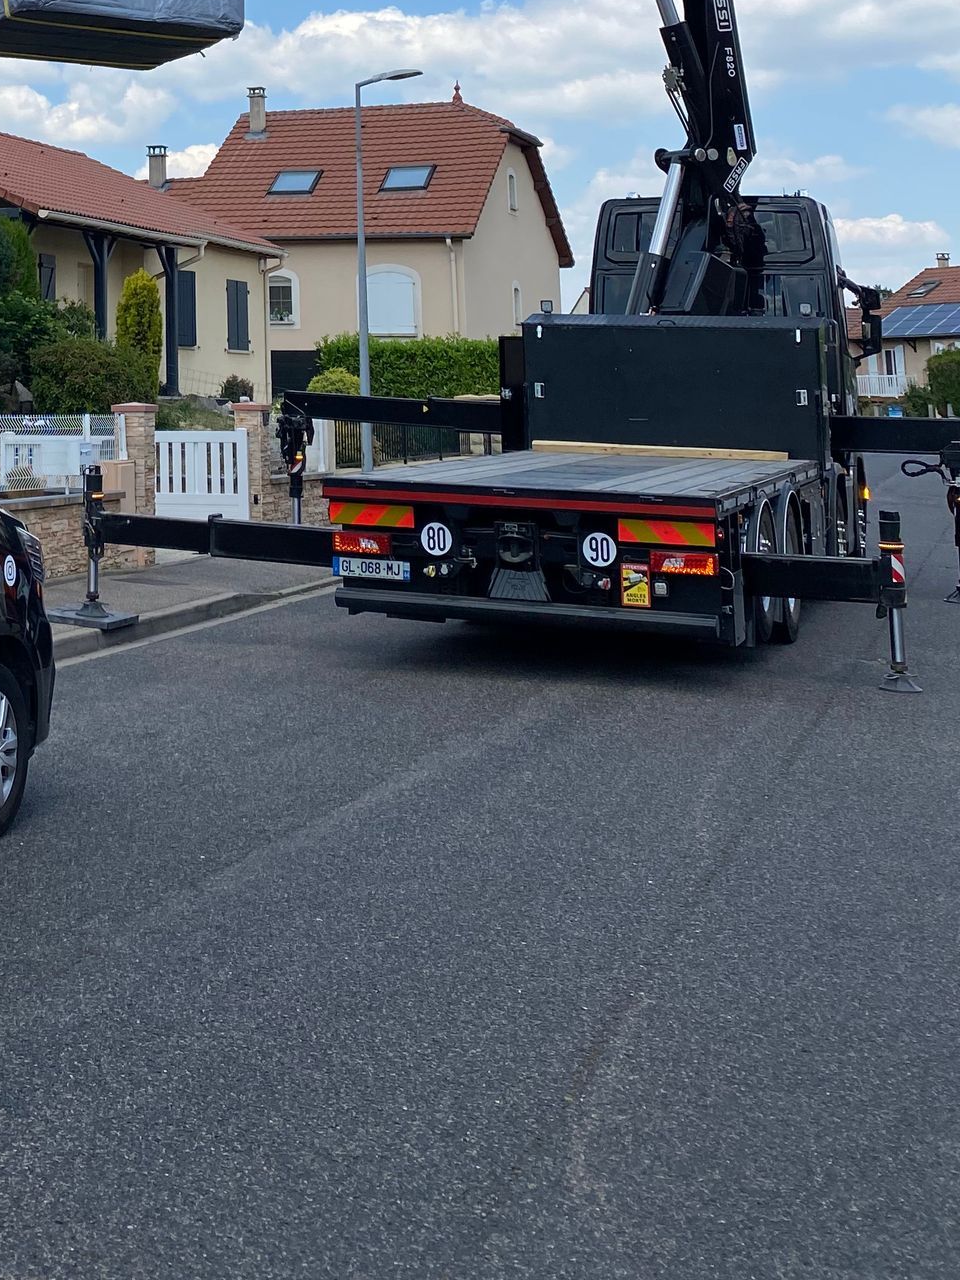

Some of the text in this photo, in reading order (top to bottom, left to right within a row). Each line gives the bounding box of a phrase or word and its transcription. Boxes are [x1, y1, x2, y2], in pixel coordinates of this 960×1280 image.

[724, 47, 736, 77] F820
[726, 160, 746, 189] FASSI
[427, 526, 446, 552] 80
[589, 536, 610, 563] 90
[341, 560, 400, 576] GL-068-MJ
